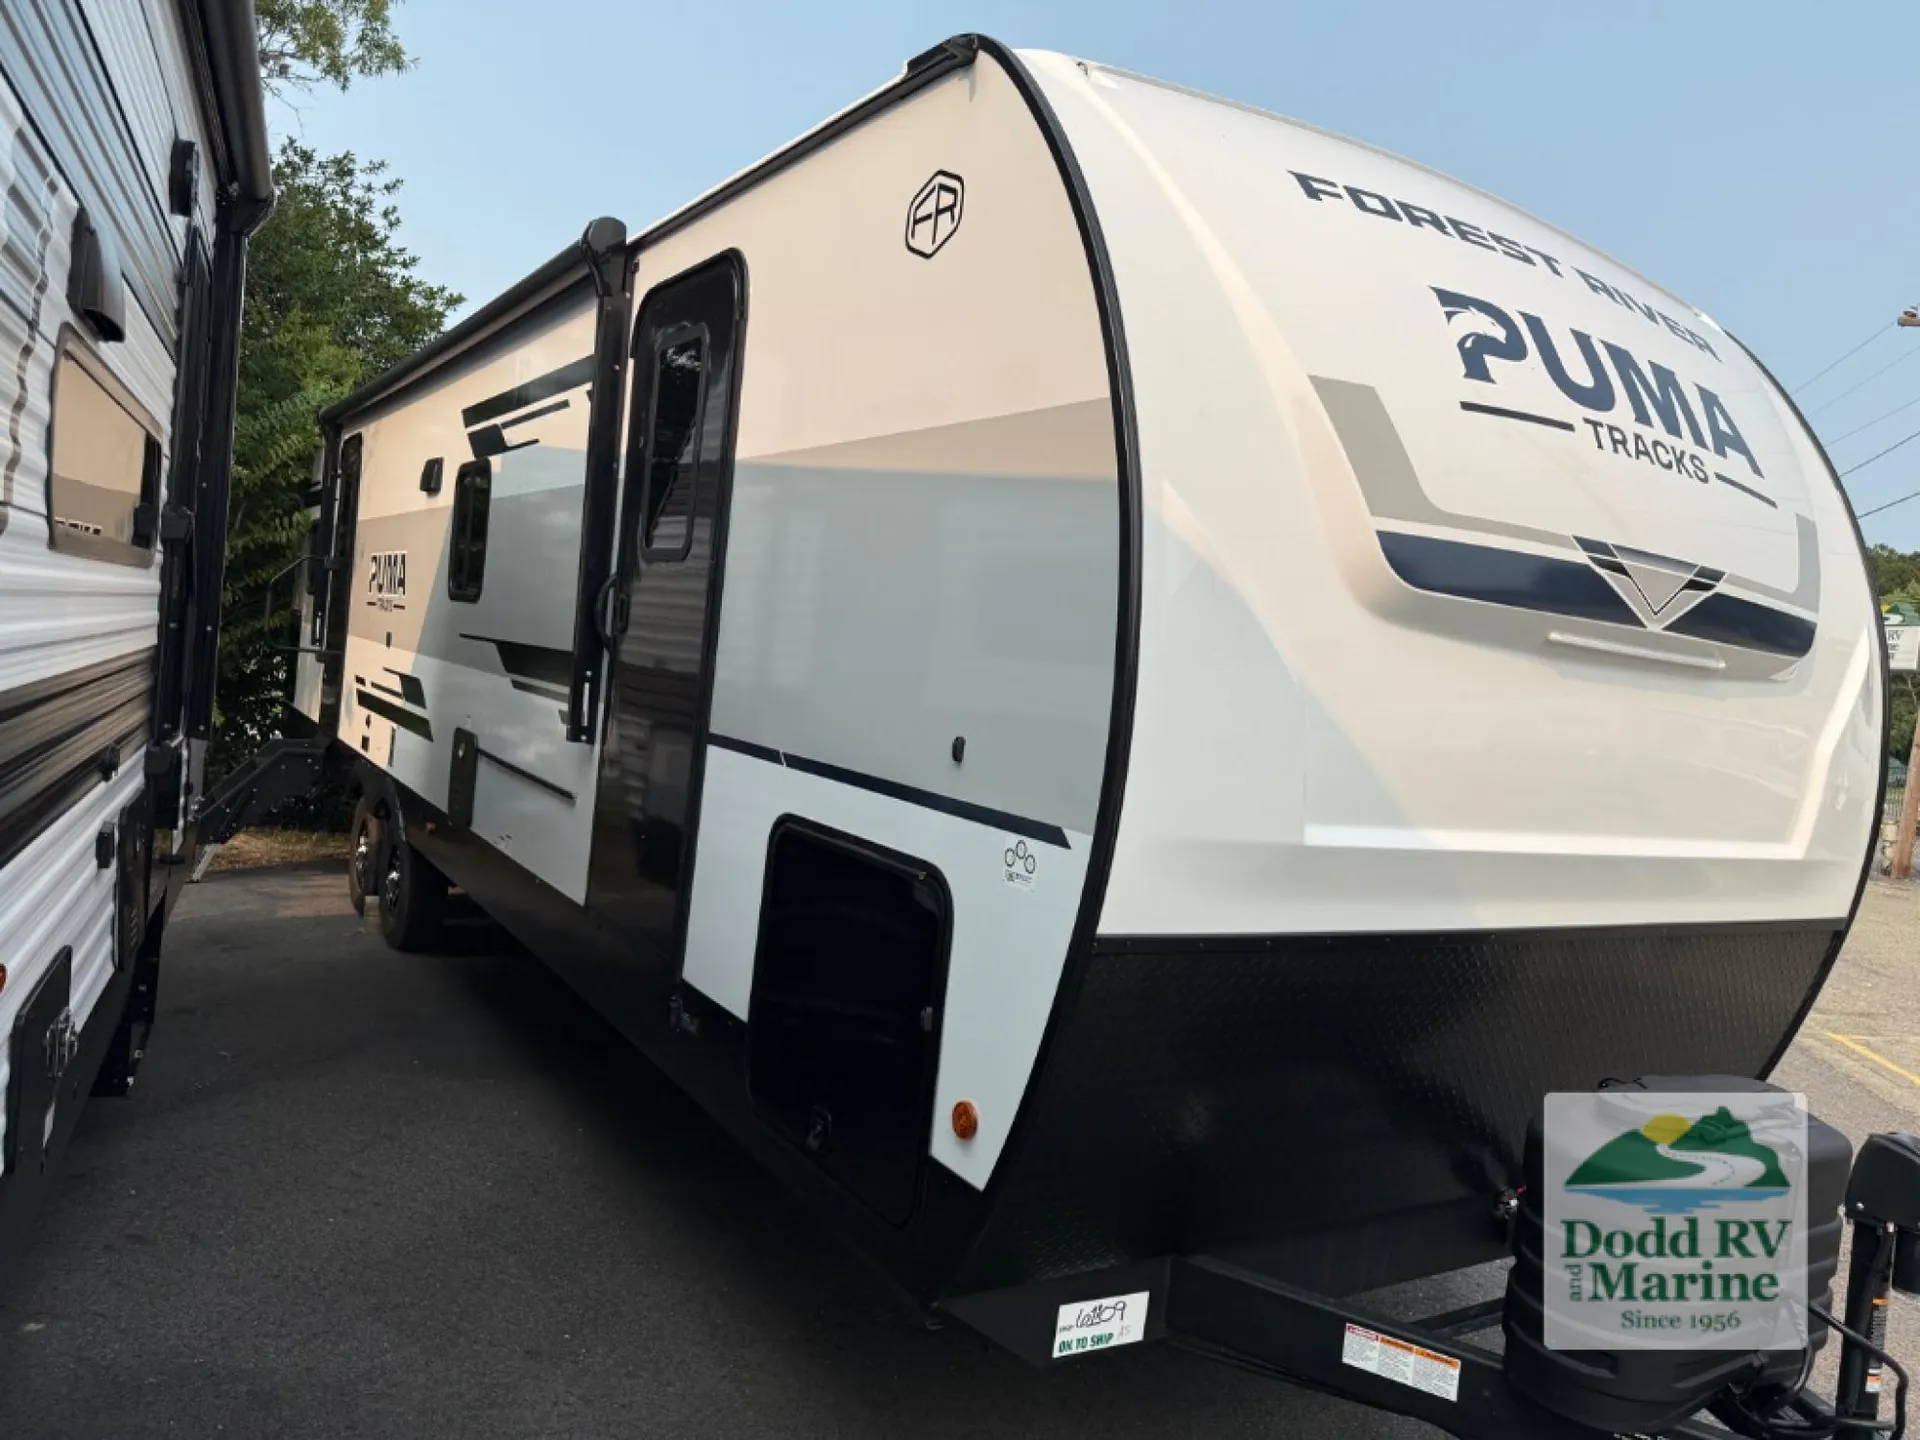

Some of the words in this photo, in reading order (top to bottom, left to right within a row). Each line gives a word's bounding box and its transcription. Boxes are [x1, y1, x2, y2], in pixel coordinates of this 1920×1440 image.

[1286, 168, 1564, 279] FOREST
[1571, 266, 1723, 363] RIVER
[1429, 285, 1765, 479] PUMA
[1581, 417, 1710, 484] TRACKS
[368, 553, 406, 597] PUMA
[1058, 1340, 1073, 1353] OK
[1076, 1336, 1088, 1350] TO
[1090, 1332, 1114, 1347] SHIP
